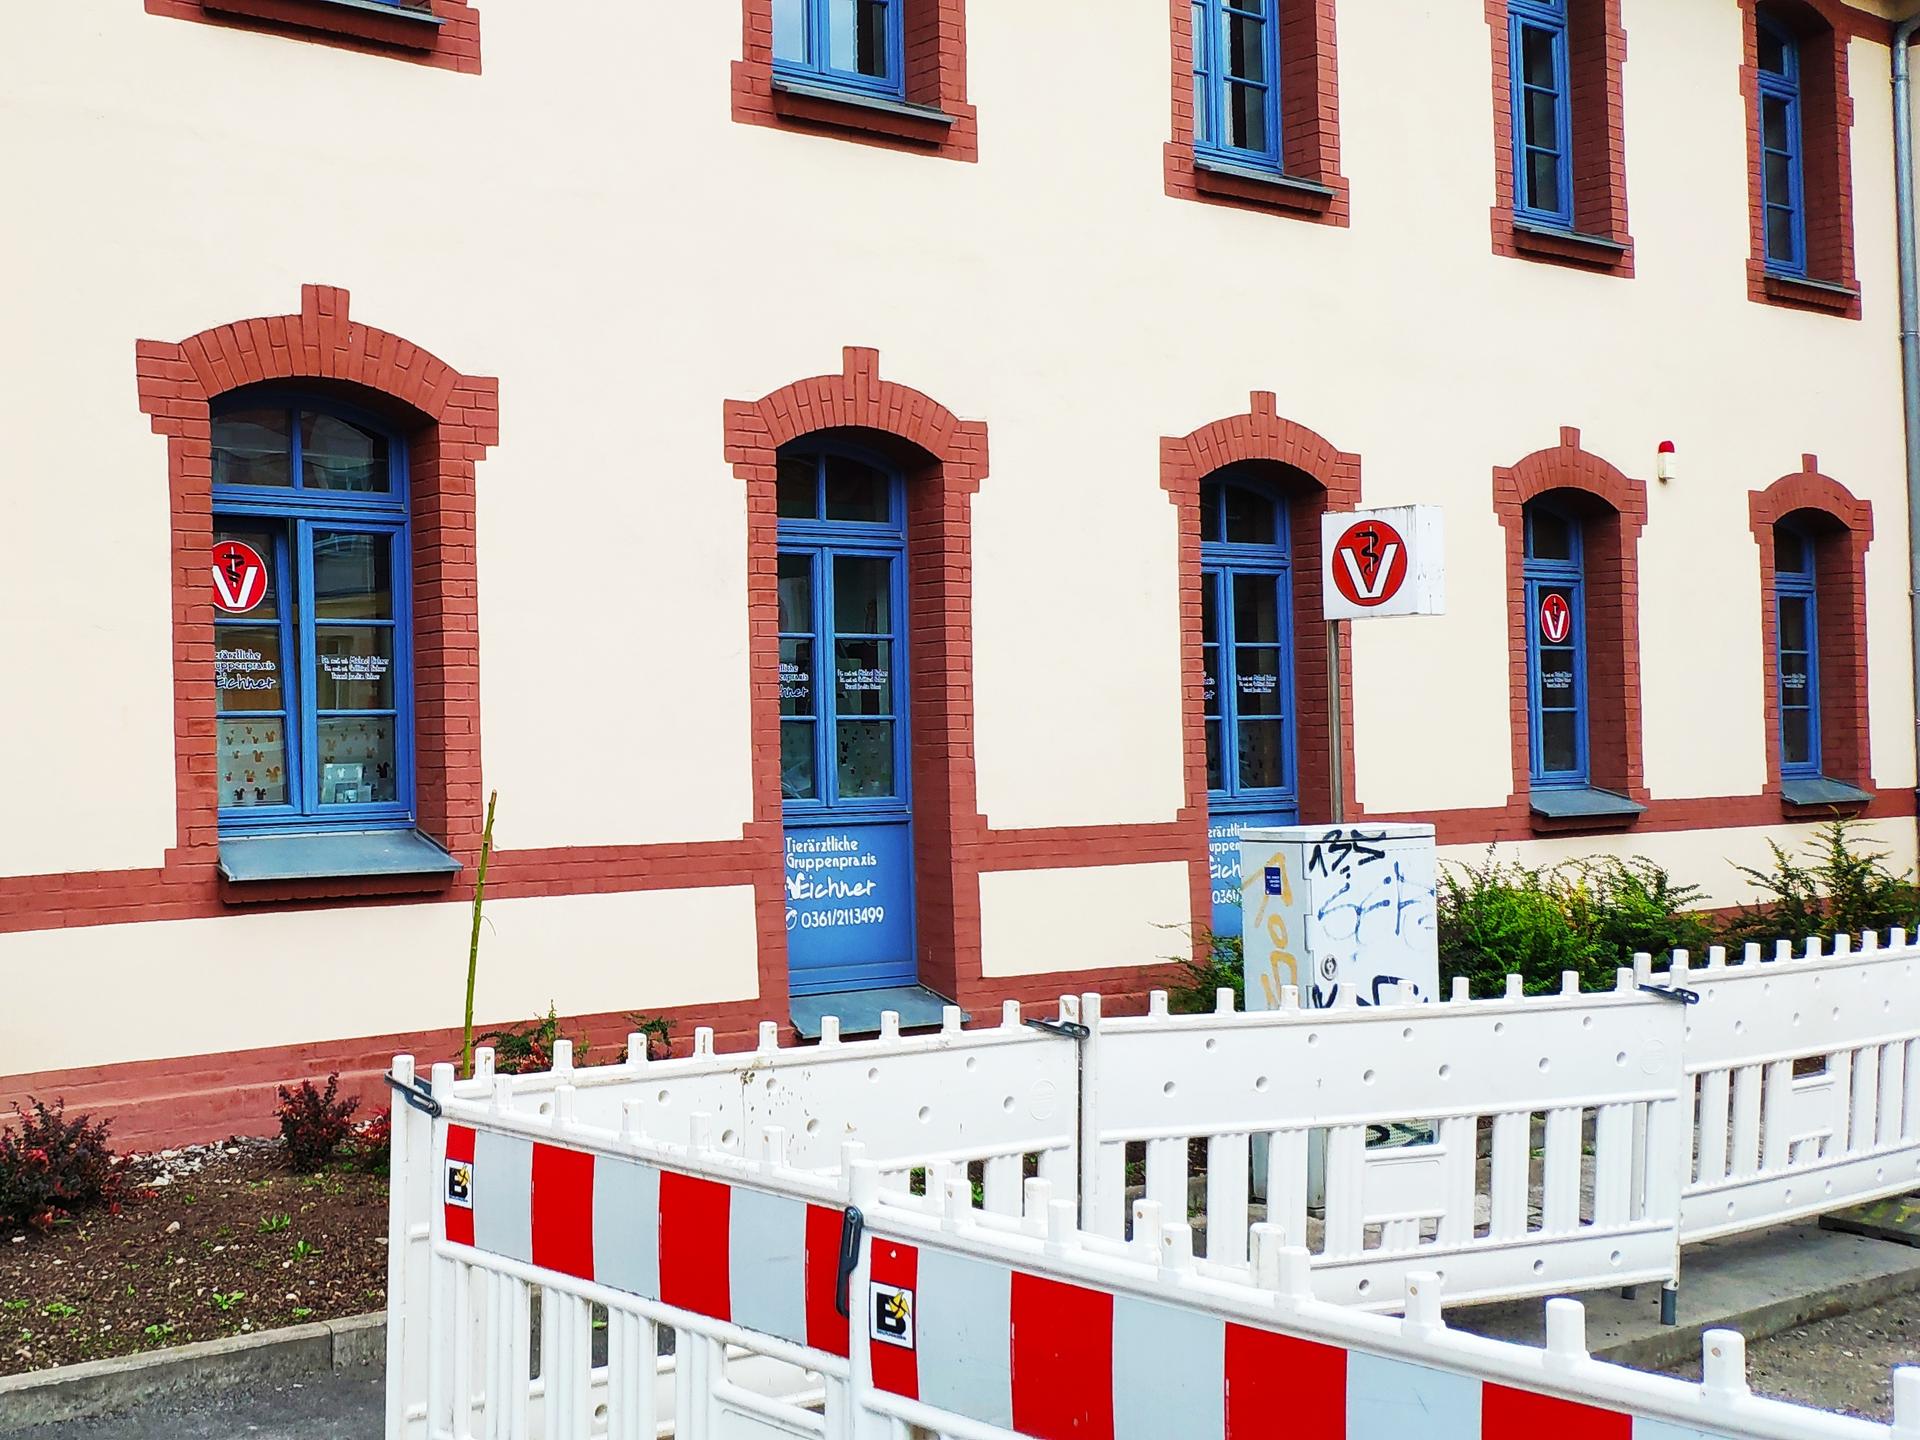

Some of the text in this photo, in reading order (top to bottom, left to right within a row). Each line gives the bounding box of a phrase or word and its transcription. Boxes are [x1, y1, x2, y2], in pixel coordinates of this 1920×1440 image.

[785, 834, 859, 853] Tierärztliche
[786, 852, 877, 872] Gruppenpraxis
[801, 906, 884, 929] 0361/2113499
